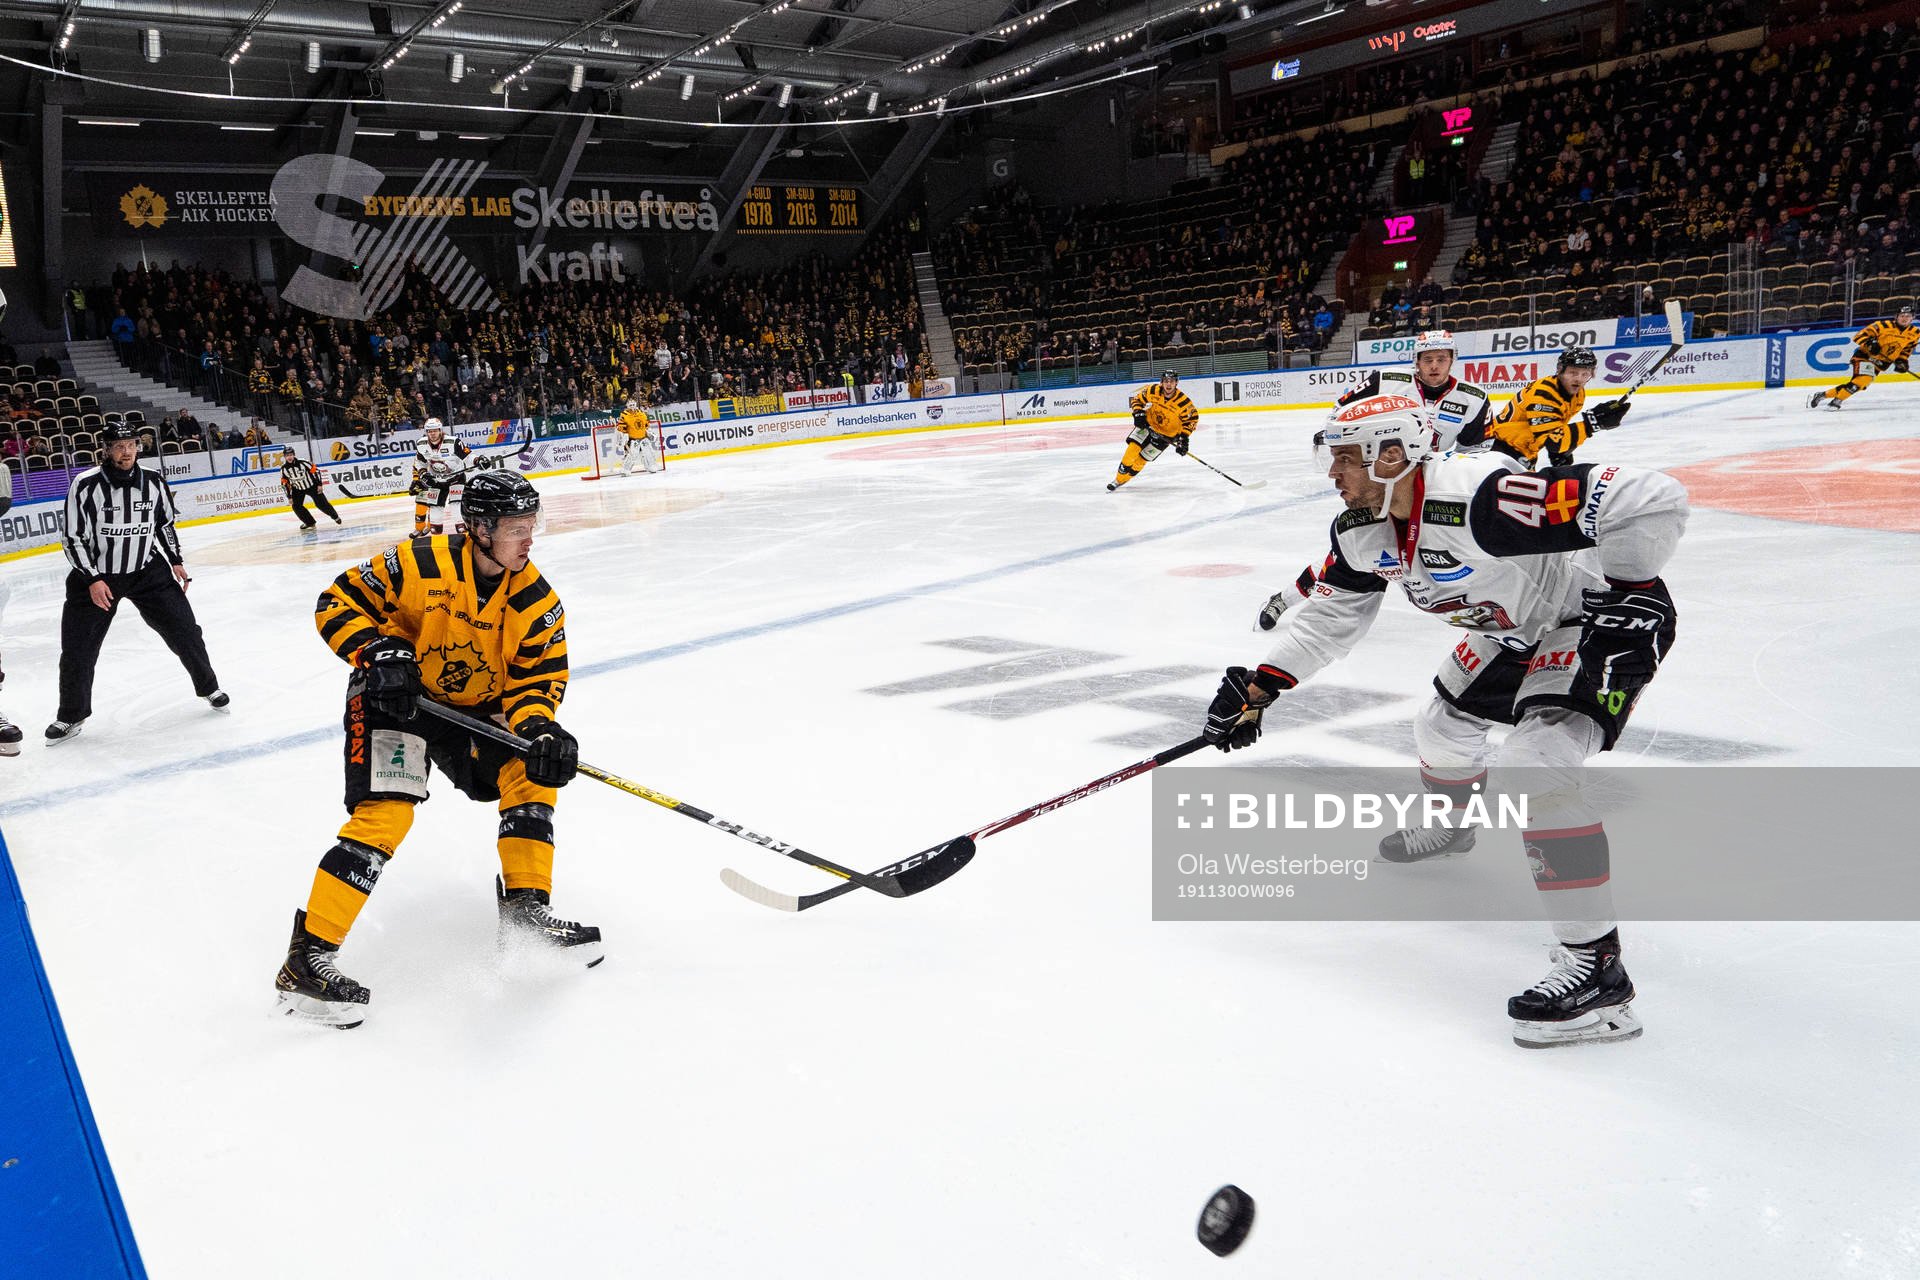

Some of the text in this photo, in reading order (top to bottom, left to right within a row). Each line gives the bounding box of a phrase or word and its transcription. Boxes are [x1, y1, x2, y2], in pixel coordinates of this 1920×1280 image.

[1413, 20, 1456, 39] Outotec
[1442, 107, 1472, 130] YP
[993, 159, 1008, 177] G
[786, 186, 815, 201] SM-GULD
[182, 208, 277, 222] AIK HOCKEY
[362, 196, 512, 217] BYGDENS LAG
[511, 187, 719, 232] Skellefteå
[743, 202, 773, 226] 1978
[787, 202, 817, 226] 2013
[830, 203, 859, 226] 2014
[1383, 216, 1415, 239] YP
[517, 242, 626, 285] Kraft
[1491, 330, 1597, 353] Henson
[1771, 338, 1782, 380] CCM
[1464, 362, 1538, 383] MAXI
[1662, 364, 1696, 376] Kraft
[1245, 381, 1282, 389] FORDONS
[1245, 389, 1282, 398] MONTAGE
[1053, 398, 1089, 407] Miljöteknik
[1346, 398, 1411, 420] navigator
[1442, 401, 1464, 414] RSA
[757, 416, 827, 434] energiservice
[837, 411, 917, 428] Handelsbanken
[697, 425, 754, 443] HULTDINS
[1374, 427, 1401, 437] CCM
[552, 443, 589, 454] Skellefteå
[553, 454, 573, 463] Kraft
[331, 464, 403, 484] valutec
[196, 490, 244, 503] MANDALAY
[1497, 474, 1547, 528] 40
[134, 502, 153, 511] SHL
[100, 524, 153, 537] swedol
[1421, 553, 1452, 566] RSA
[374, 648, 417, 662] CC
[1456, 641, 1482, 672] AXI
[547, 680, 566, 702] 5
[375, 769, 425, 784] martinsons
[1029, 776, 1122, 820] JETSPEED
[708, 815, 797, 856] CCM
